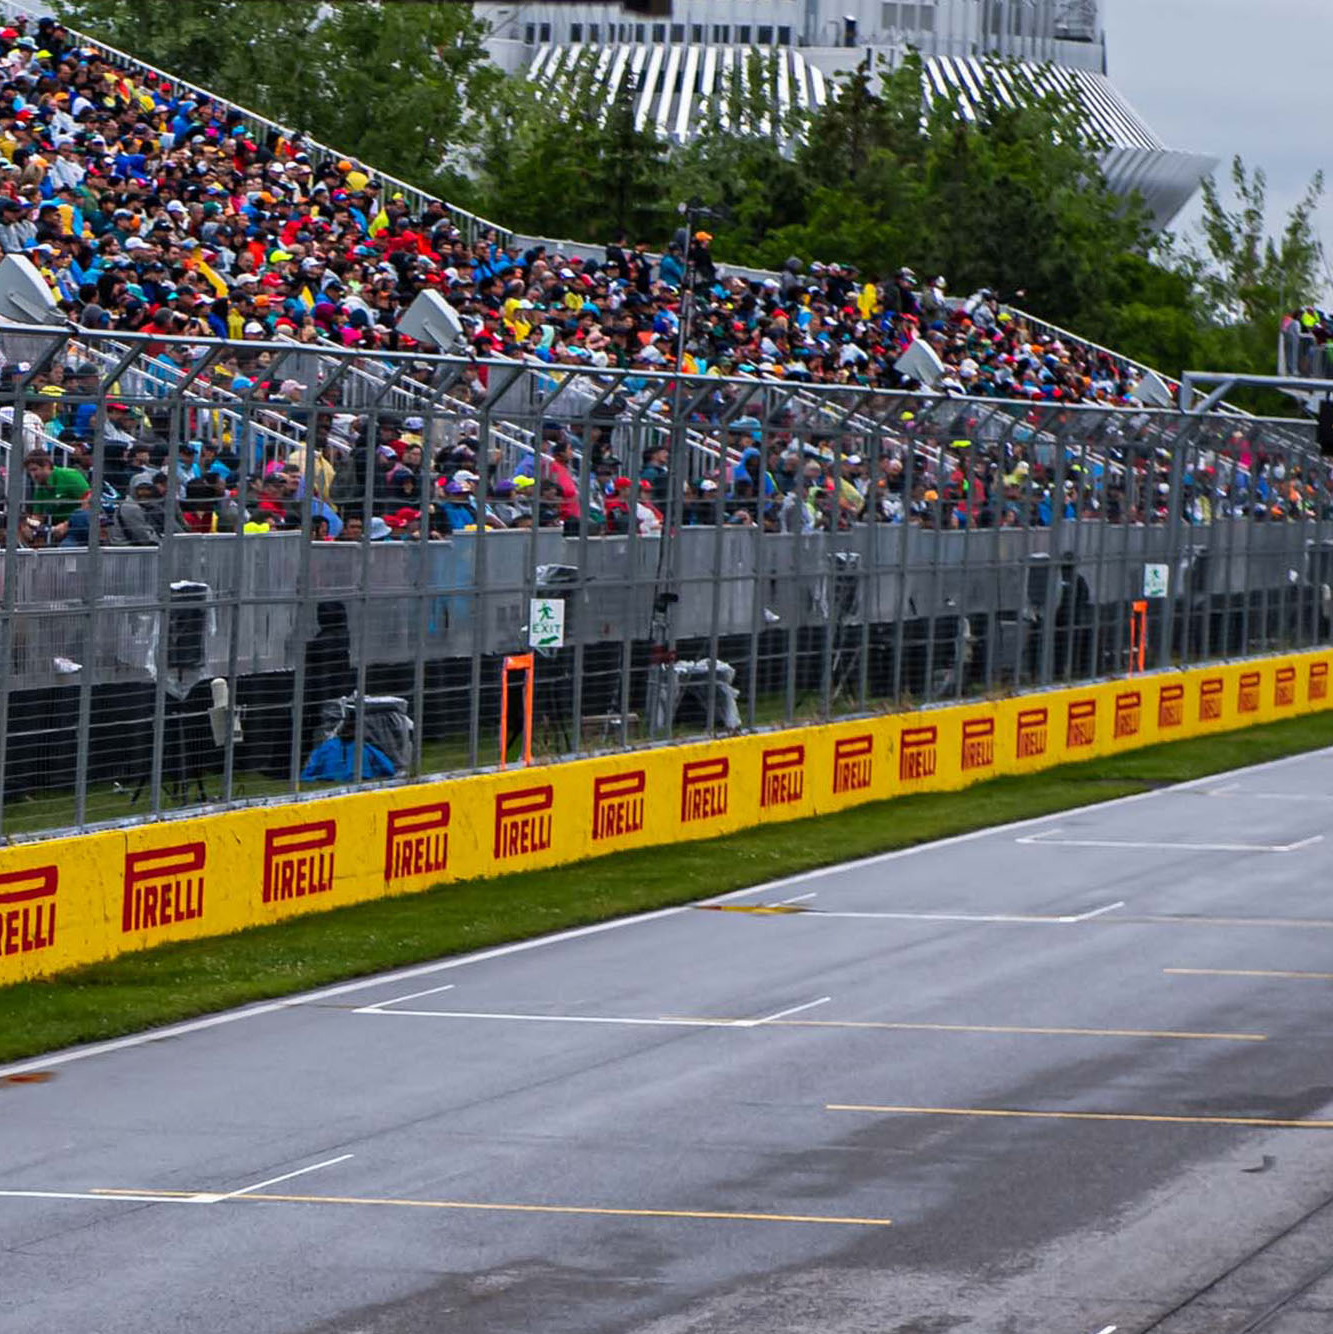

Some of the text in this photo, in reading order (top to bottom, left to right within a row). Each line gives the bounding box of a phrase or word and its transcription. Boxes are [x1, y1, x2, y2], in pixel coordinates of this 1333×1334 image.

[532, 623, 561, 634] EXIT
[761, 744, 805, 808] PIRELLI
[833, 734, 872, 793] PIRELLI
[900, 726, 937, 780] PIRELLI
[494, 785, 554, 860] PIRELLI
[593, 770, 646, 840] PIRELLI
[681, 757, 729, 822] PIRELLI
[263, 820, 336, 904] PIRELLI
[385, 802, 450, 882] PIRELLI
[122, 842, 206, 933] PIRELLI
